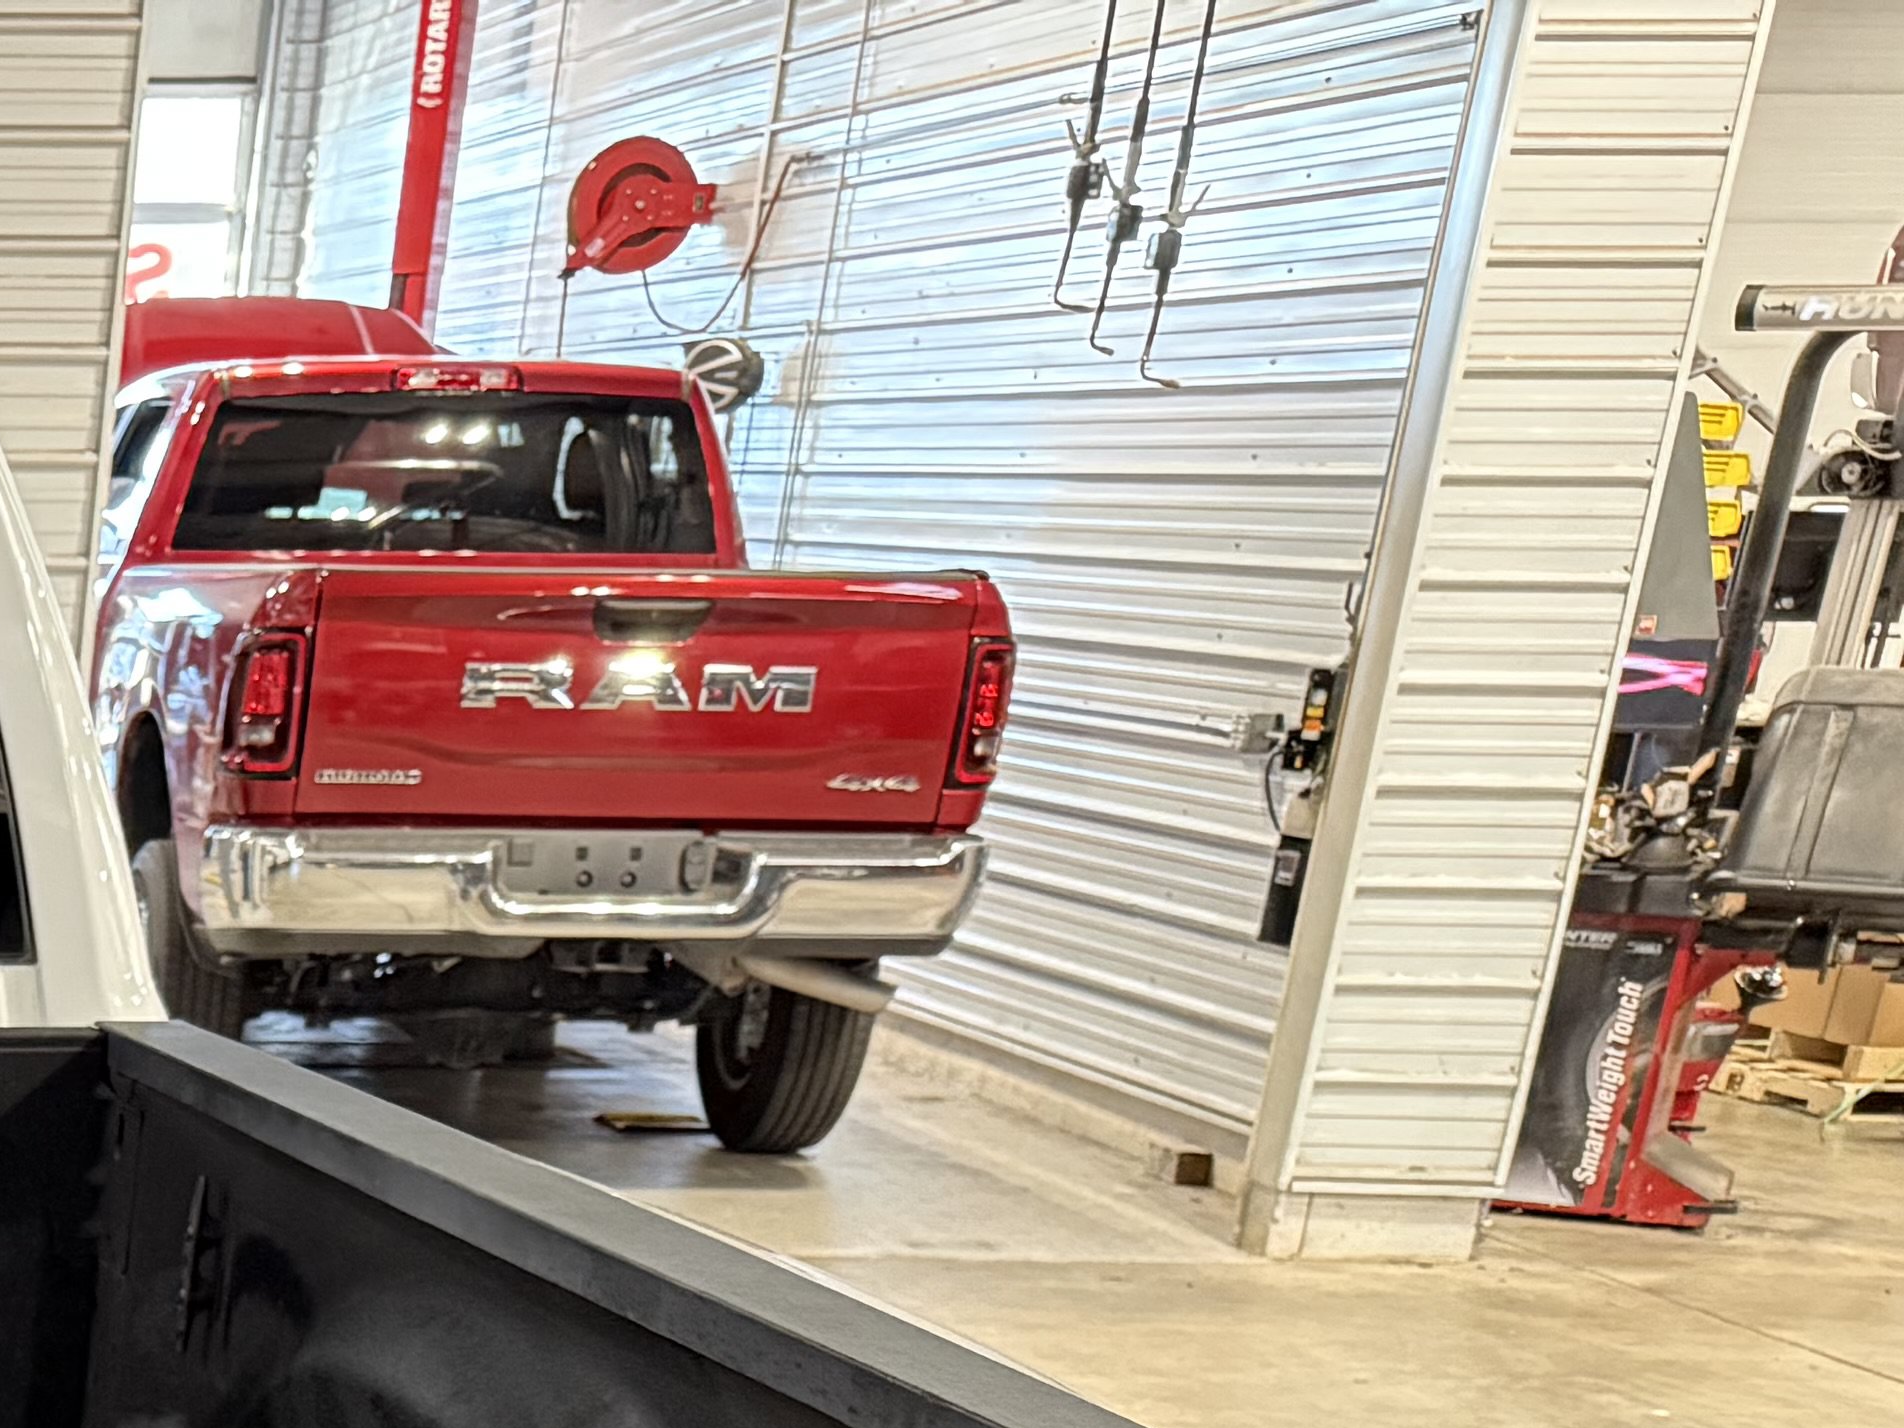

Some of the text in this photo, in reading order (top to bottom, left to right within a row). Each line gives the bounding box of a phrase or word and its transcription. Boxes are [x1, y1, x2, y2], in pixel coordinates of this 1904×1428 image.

[460, 661, 819, 712] RAM
[1572, 979, 1643, 1186] SmartWeight Touch
